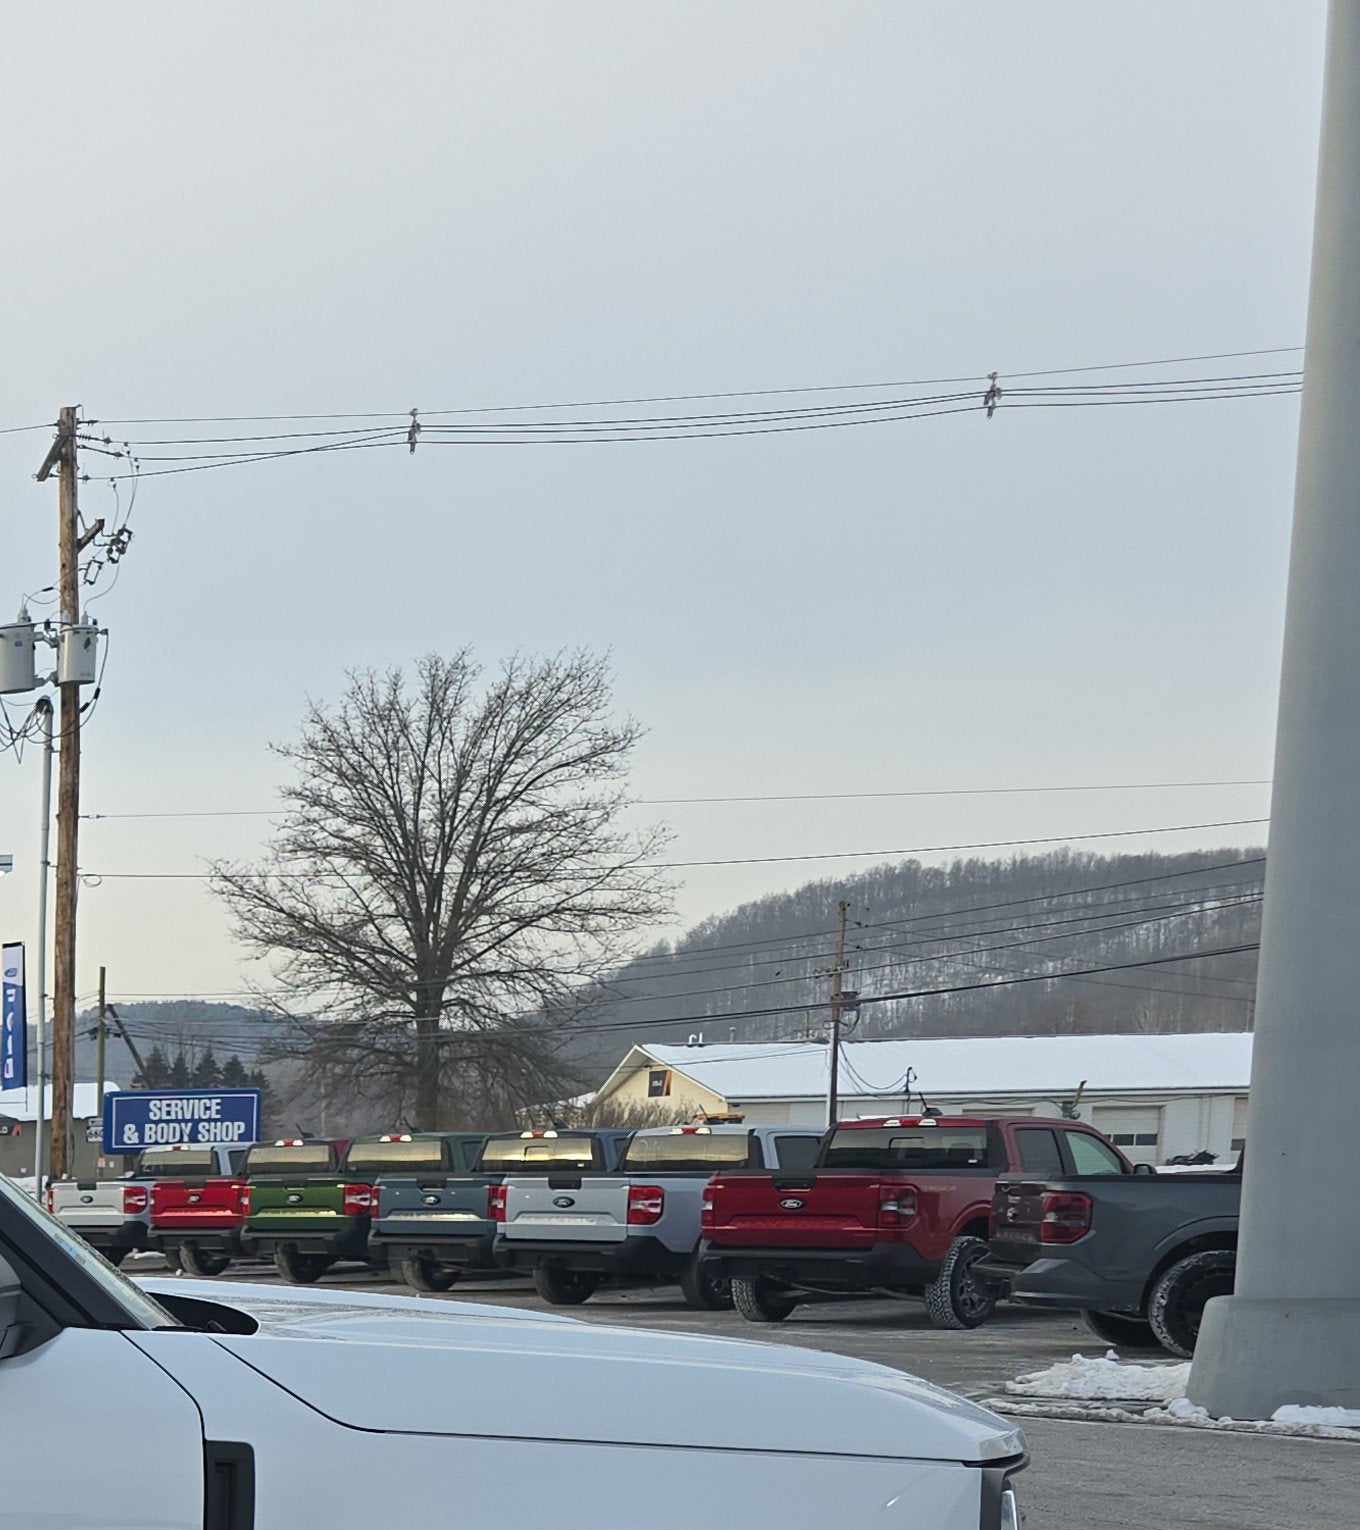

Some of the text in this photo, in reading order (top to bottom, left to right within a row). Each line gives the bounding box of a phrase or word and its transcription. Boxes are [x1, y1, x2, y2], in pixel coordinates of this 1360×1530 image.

[148, 1099, 222, 1120] SERVICE
[123, 1121, 246, 1144] & BODY SHOP
